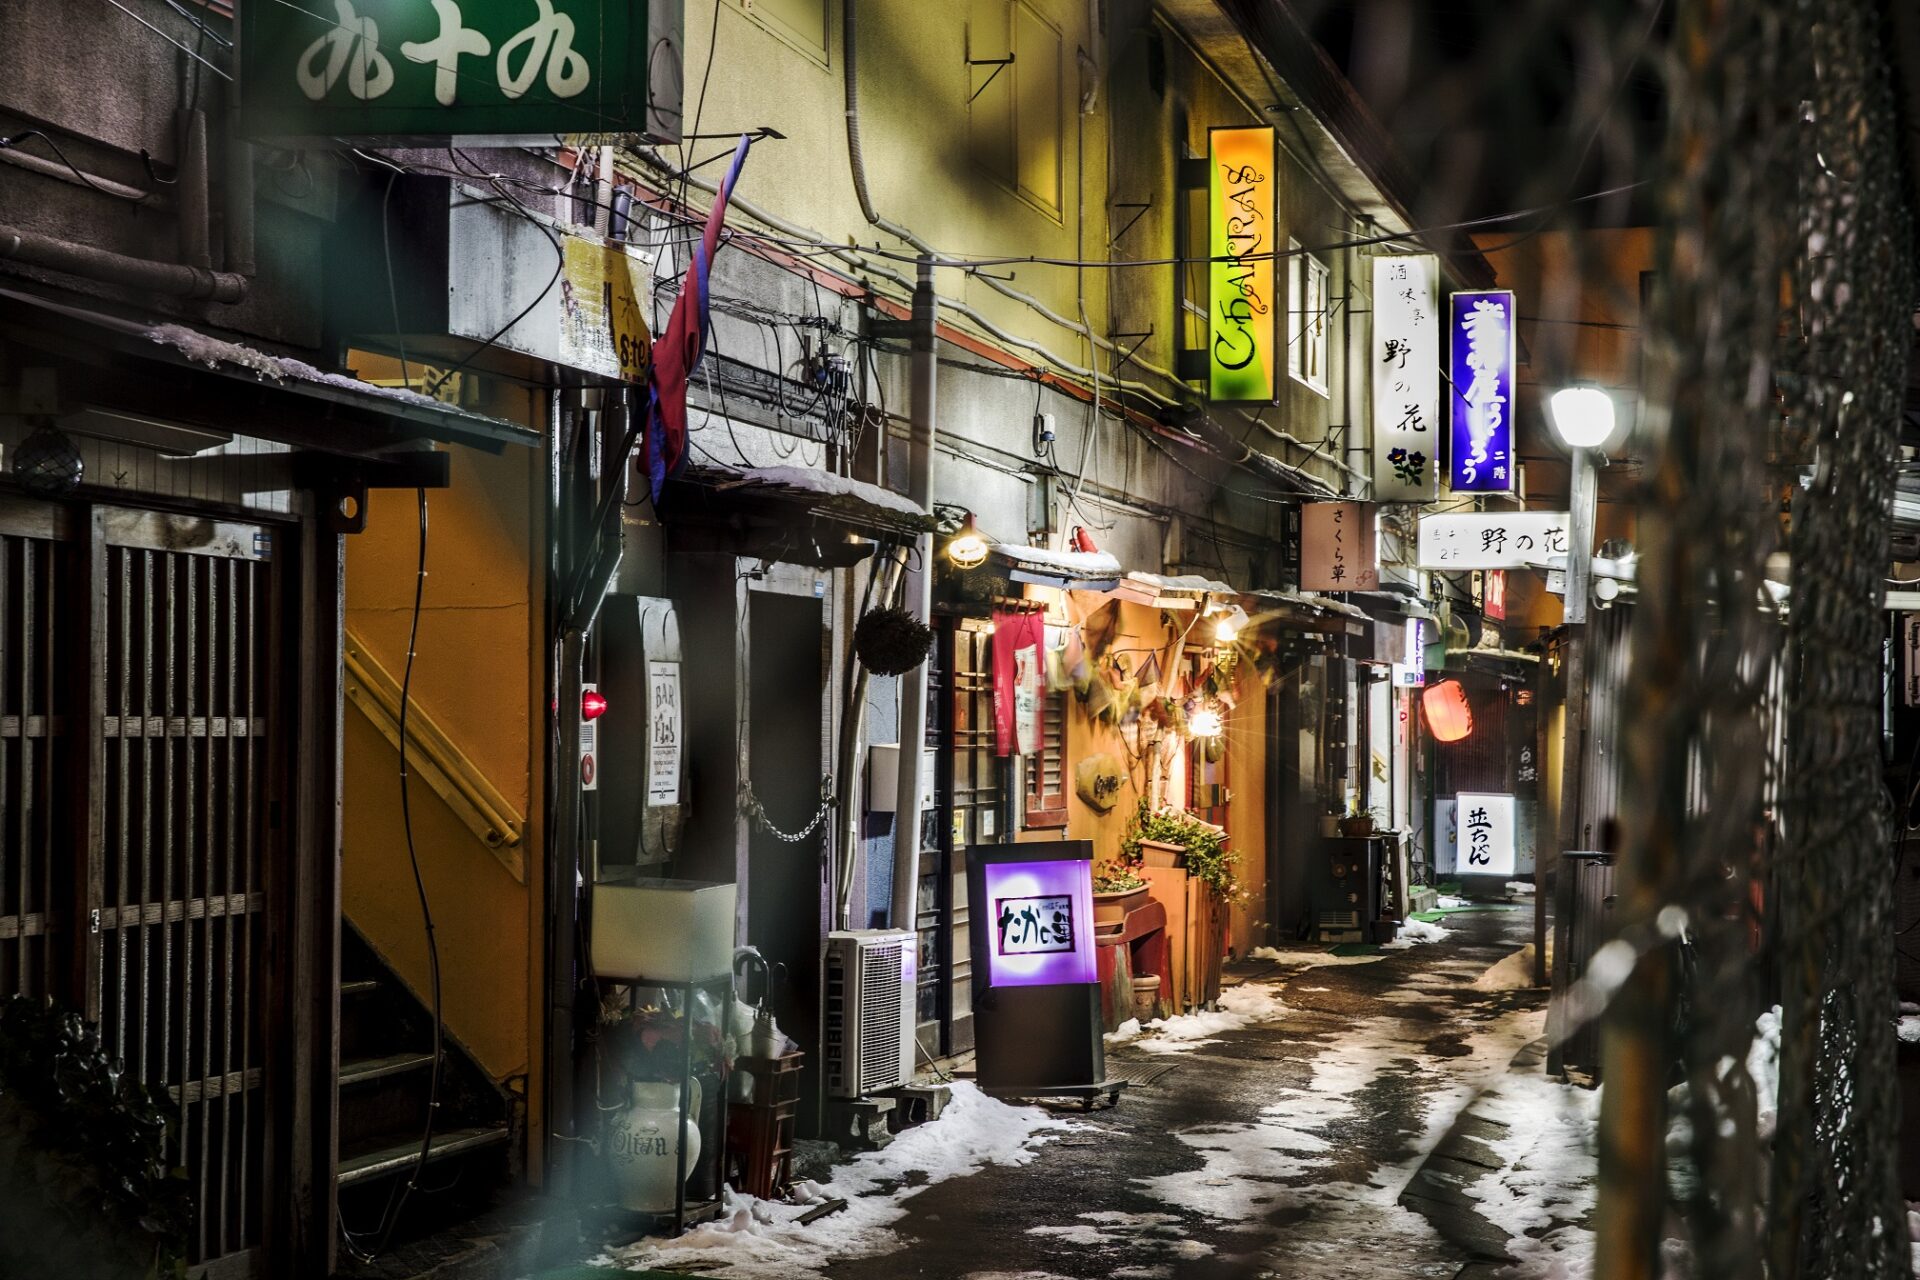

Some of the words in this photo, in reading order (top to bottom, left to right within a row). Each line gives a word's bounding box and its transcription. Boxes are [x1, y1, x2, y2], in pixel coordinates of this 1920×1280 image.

[296, 0, 591, 106] 九十九
[1383, 338, 1427, 432] 野の花
[1330, 508, 1347, 584] さくら草
[1480, 526, 1569, 554] 野の花
